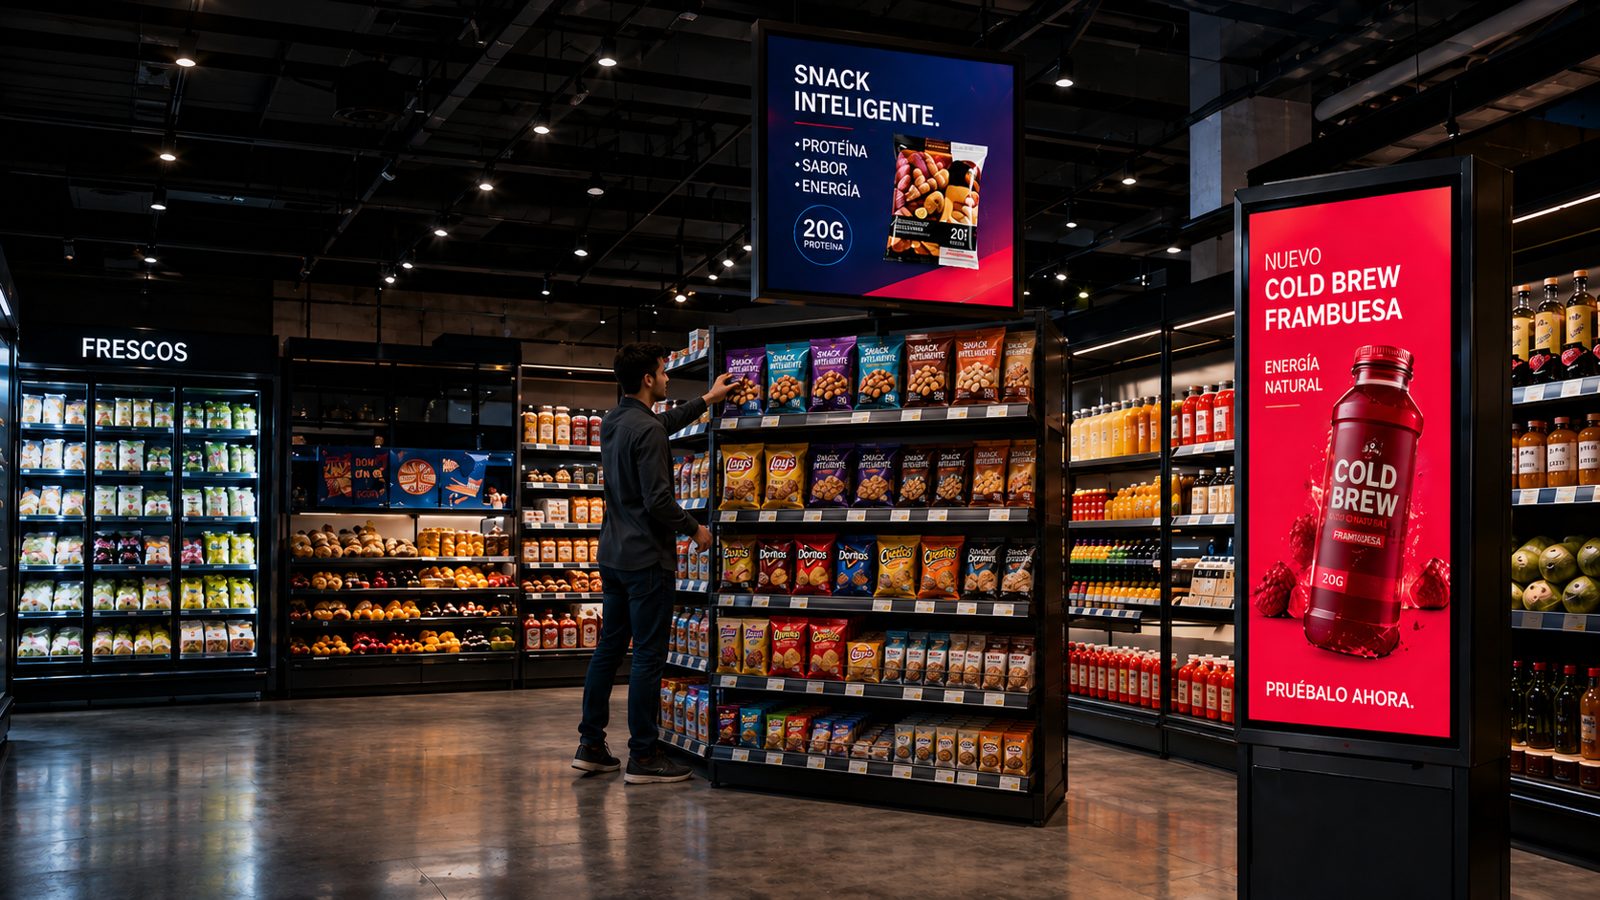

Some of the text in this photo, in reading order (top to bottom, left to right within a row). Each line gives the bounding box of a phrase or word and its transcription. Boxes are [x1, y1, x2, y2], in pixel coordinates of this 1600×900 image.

[794, 64, 870, 92] SNACK
[794, 91, 940, 127] INTELIGENTE.
[802, 159, 848, 176] SABOR
[802, 179, 861, 198] ENERGÍA
[803, 218, 844, 240] 20G
[1265, 247, 1322, 271] NUEVO
[1265, 264, 1401, 301] COLD BREW
[1265, 296, 1403, 331] FRAMBUESA
[82, 337, 188, 362] FRESCOS
[1265, 353, 1320, 375] ENERGÍA
[1265, 378, 1323, 394] NATURAL
[1334, 459, 1397, 490] COLD
[1331, 486, 1399, 517] BREW
[1322, 572, 1345, 588] 20G
[1266, 679, 1415, 709] PRUÉBALO AHORA.
